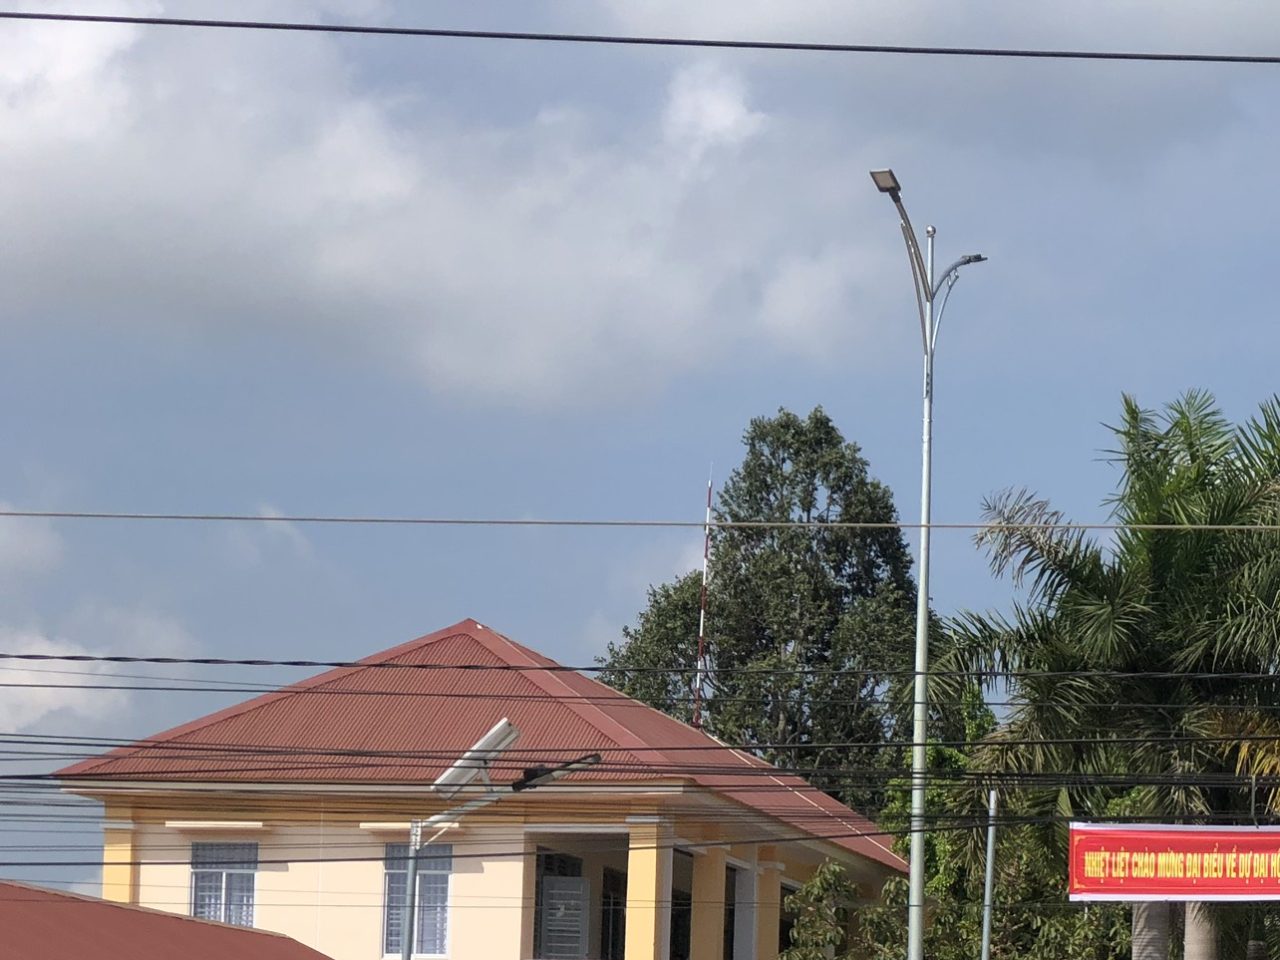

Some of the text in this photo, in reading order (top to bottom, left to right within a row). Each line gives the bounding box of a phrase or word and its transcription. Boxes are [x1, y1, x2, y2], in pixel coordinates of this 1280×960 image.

[1084, 846, 1110, 884] NHIỆT
[1111, 846, 1130, 884] LIỆT
[1132, 846, 1155, 878] CHÀO
[1157, 846, 1185, 878] MỪNG
[1186, 852, 1201, 884] ĐẠI
[1203, 842, 1223, 878] BIỂU
[1239, 850, 1253, 884] DỰ
[1253, 852, 1268, 884] ĐẠI
